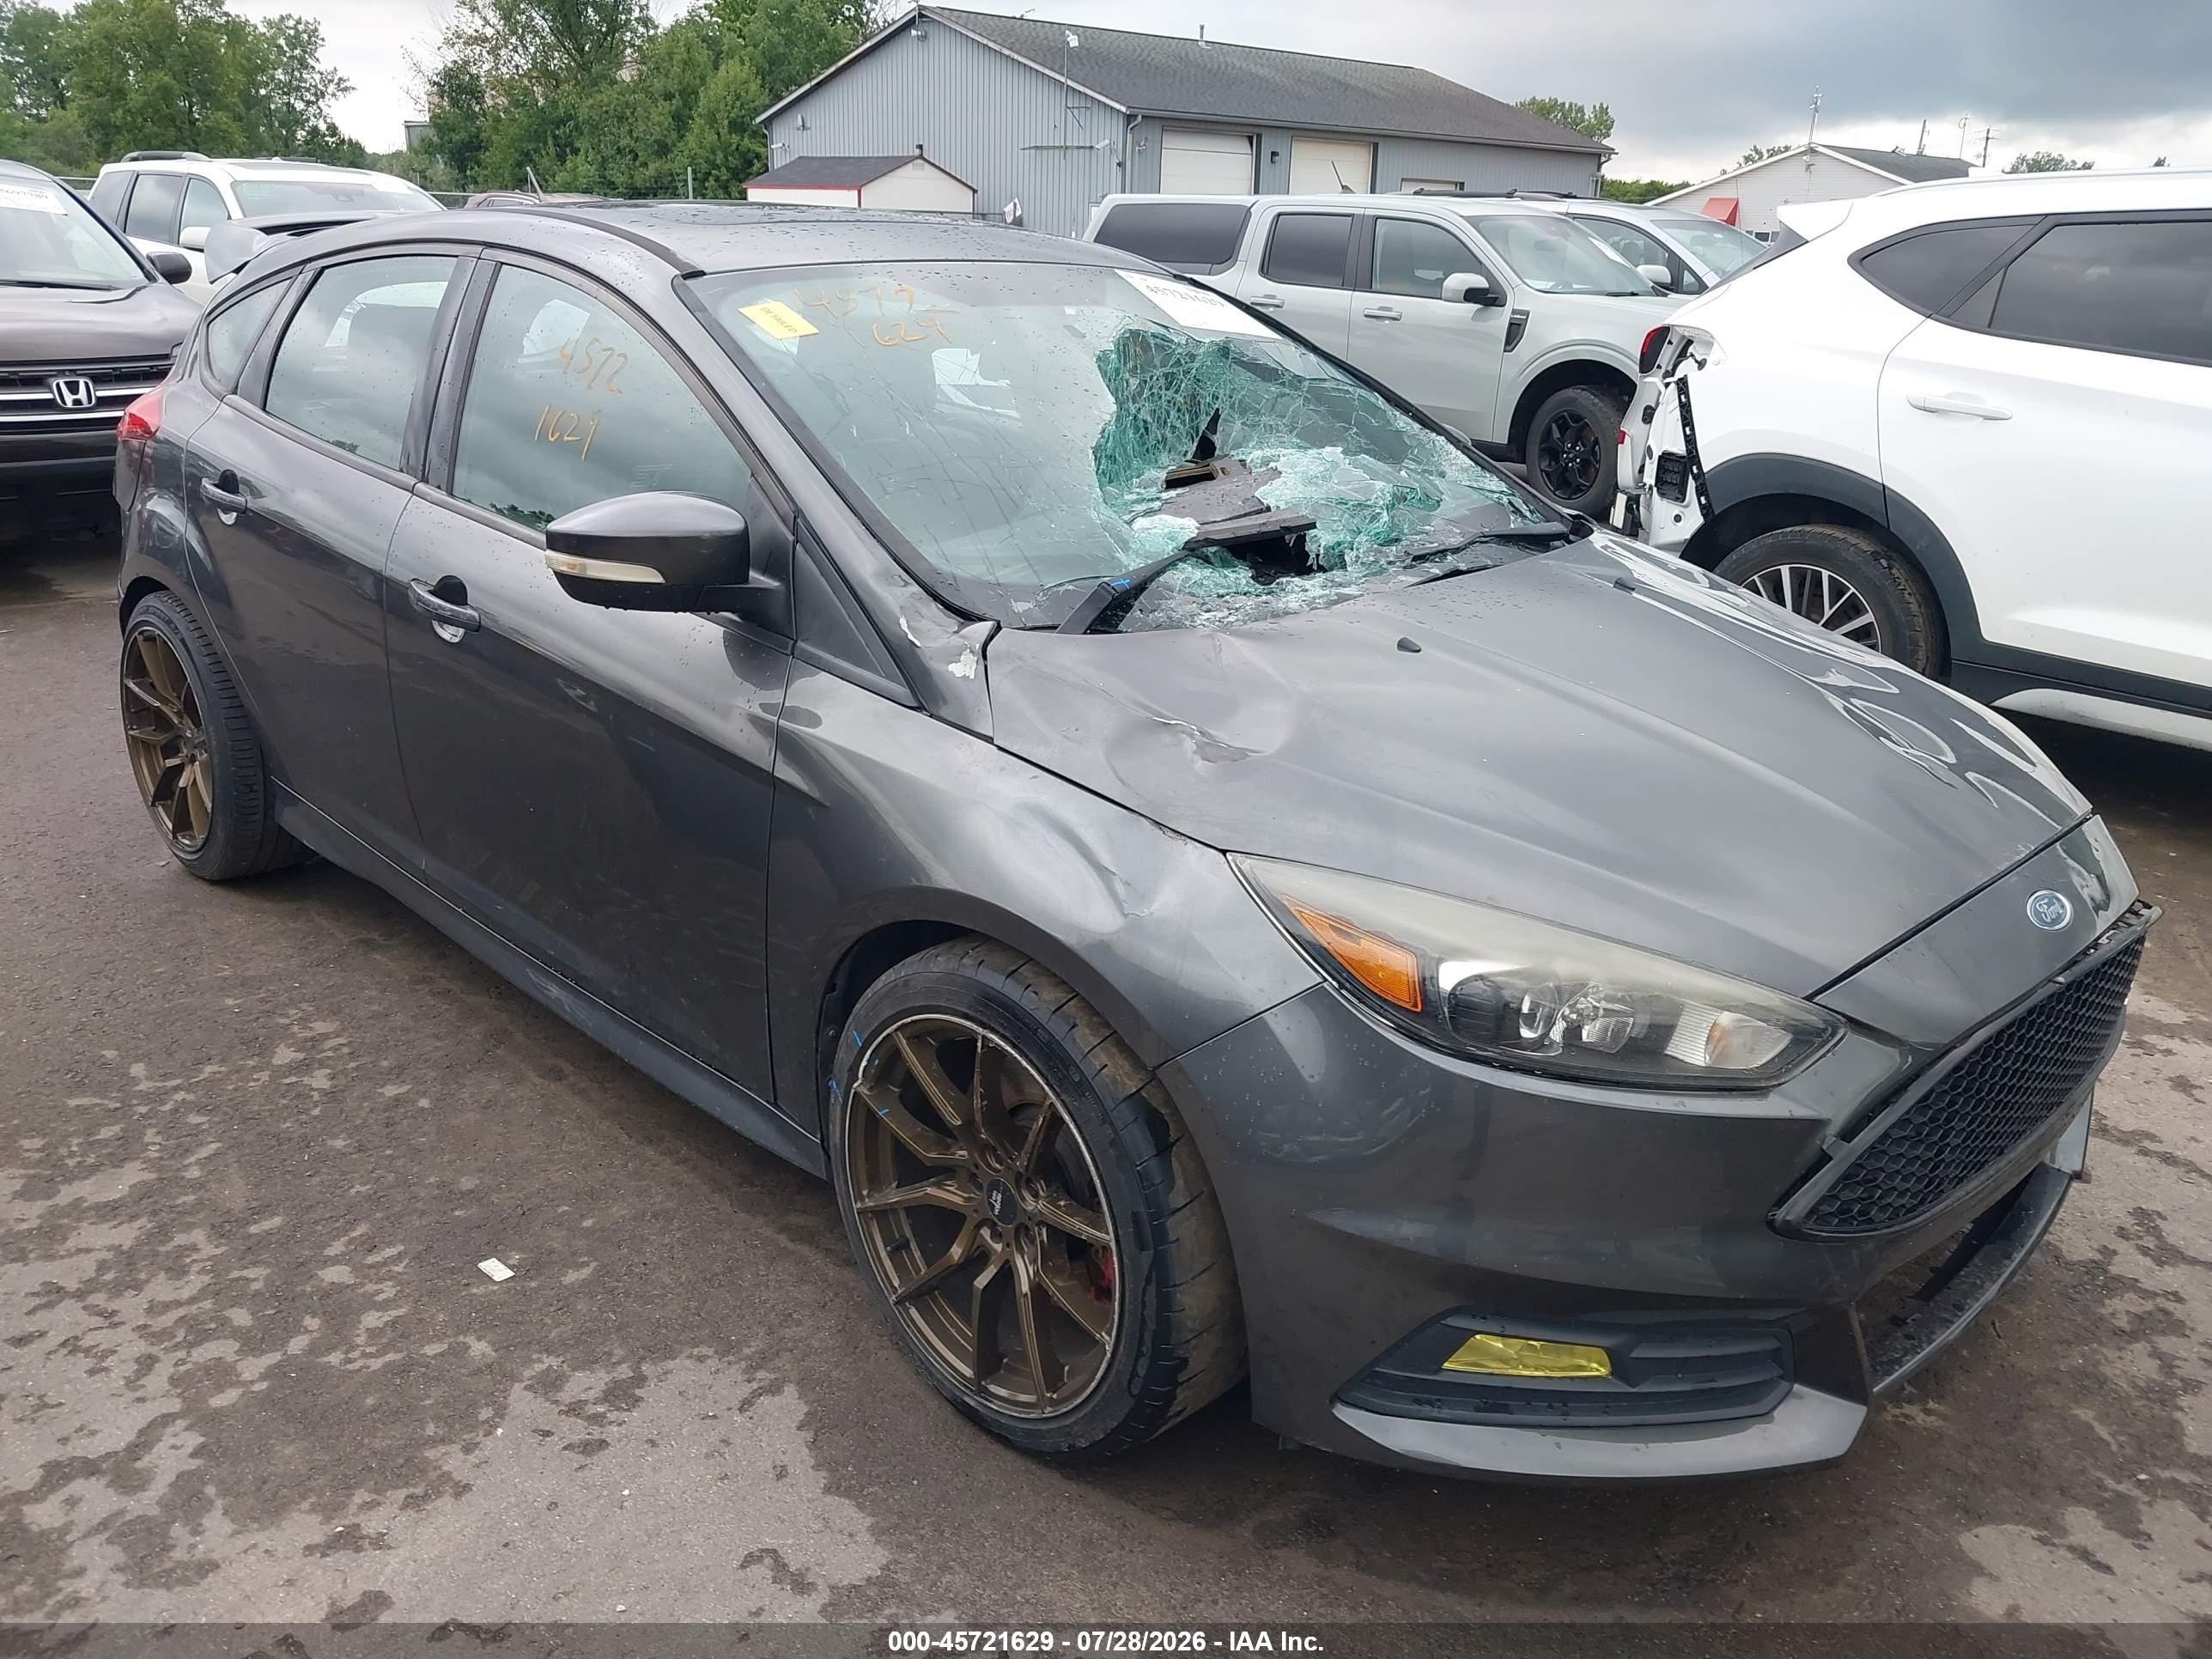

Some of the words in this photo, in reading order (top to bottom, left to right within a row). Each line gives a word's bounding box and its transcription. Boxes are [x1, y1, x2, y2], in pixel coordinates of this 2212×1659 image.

[560, 337, 629, 394] 4572
[534, 404, 602, 461] 1629
[631, 464, 673, 489] ST
